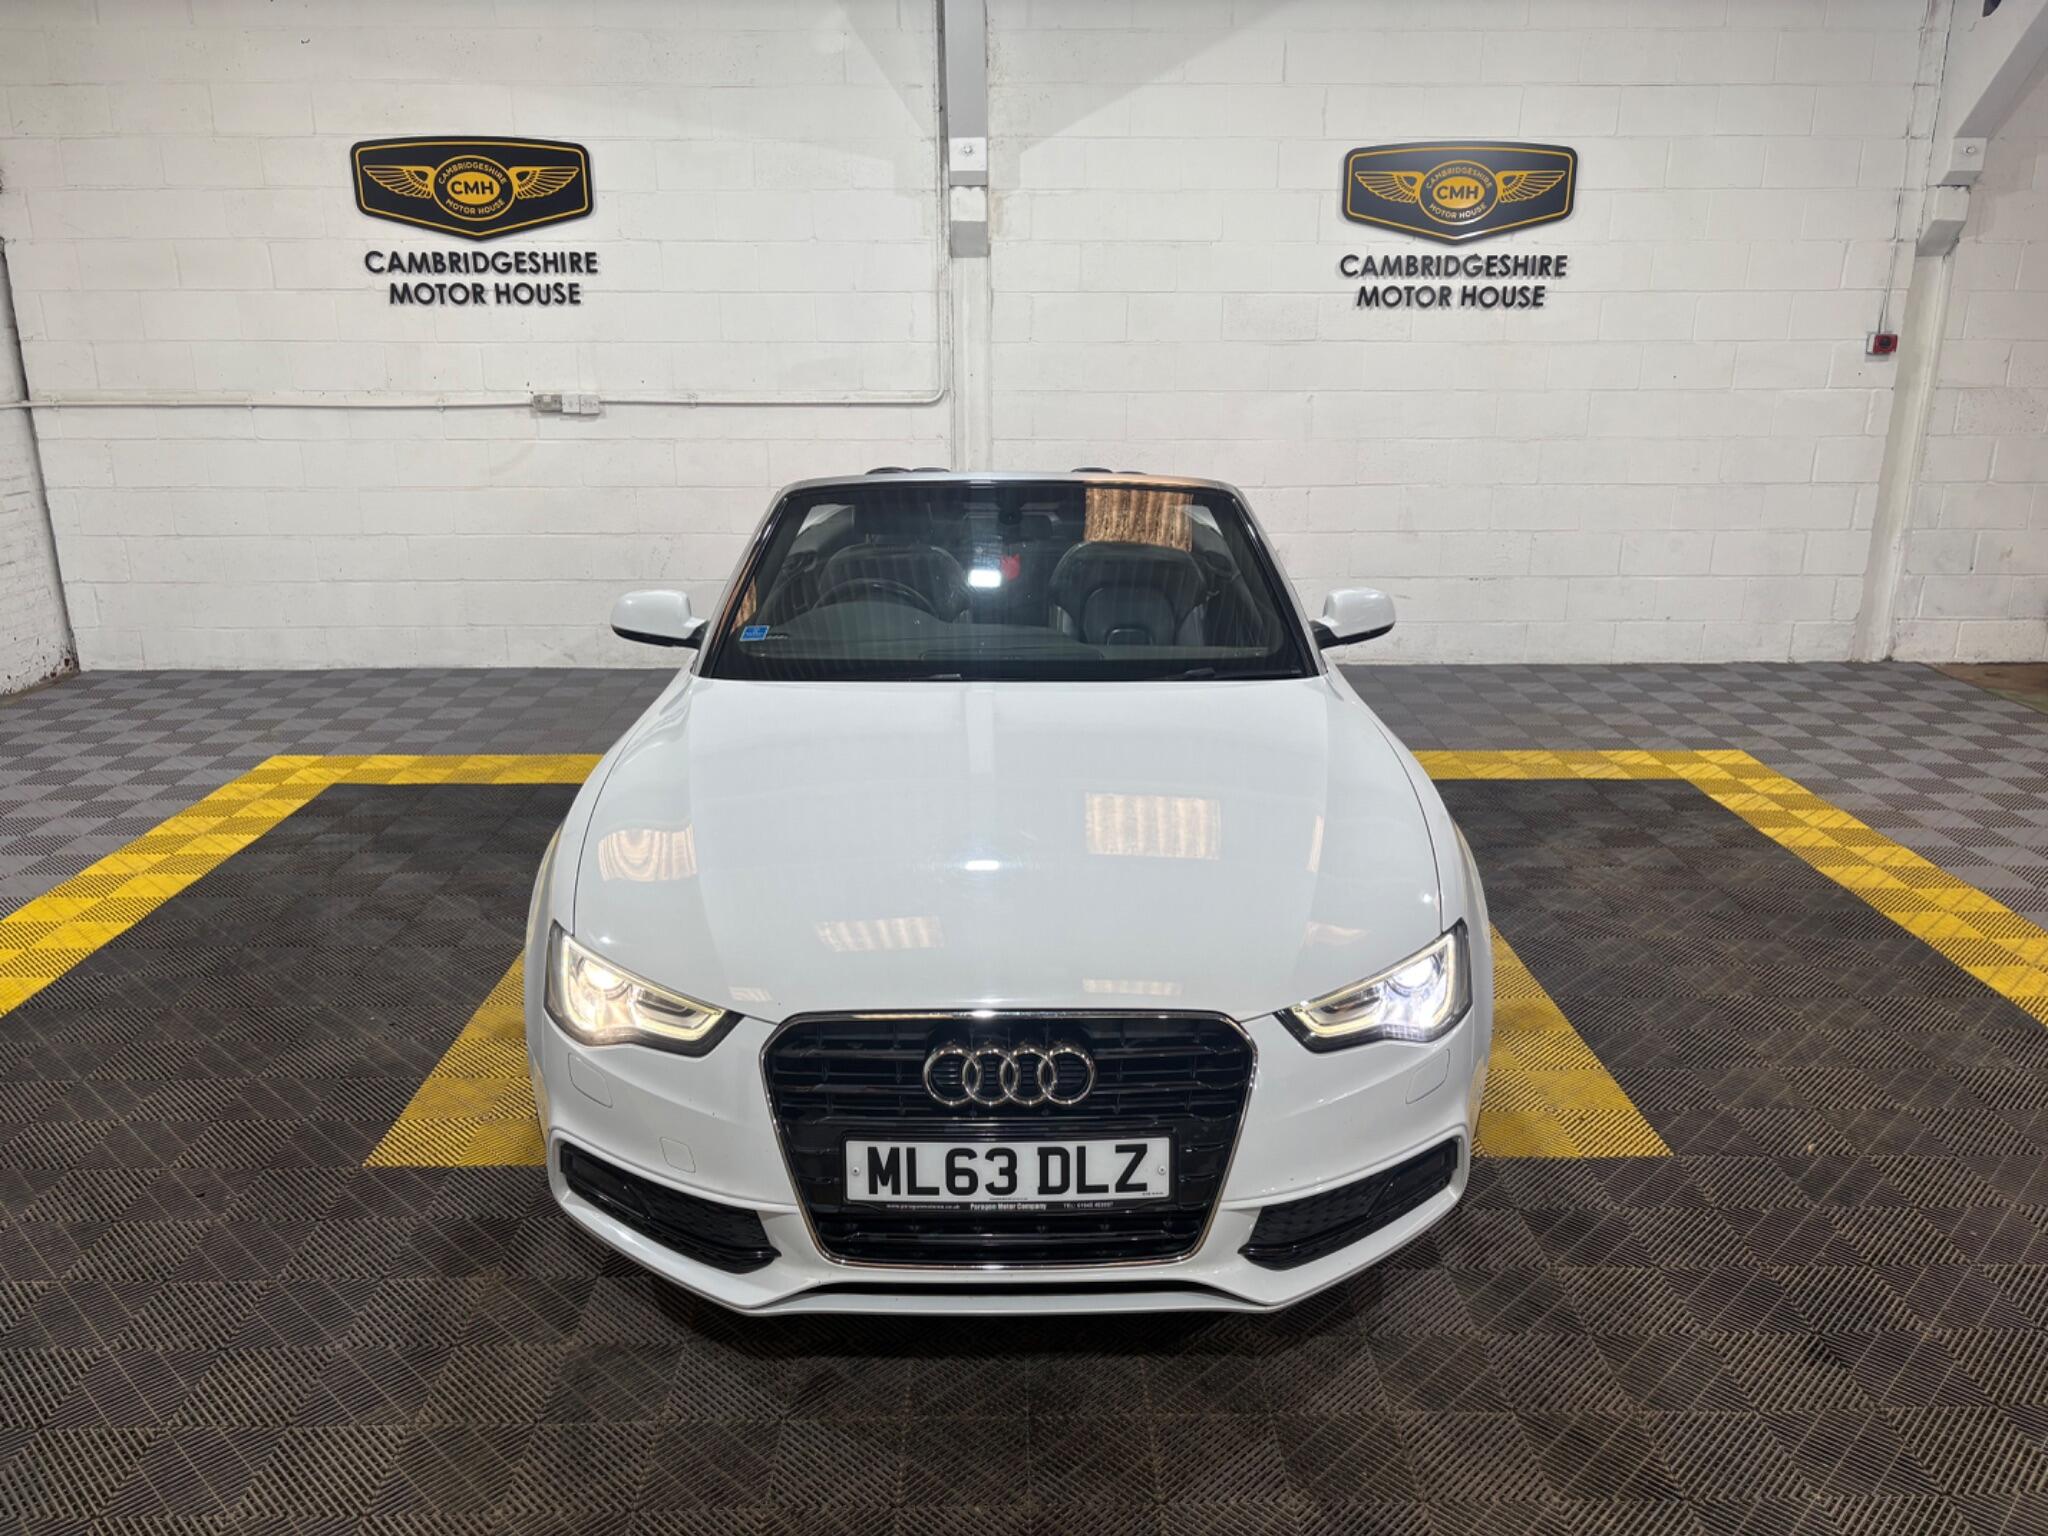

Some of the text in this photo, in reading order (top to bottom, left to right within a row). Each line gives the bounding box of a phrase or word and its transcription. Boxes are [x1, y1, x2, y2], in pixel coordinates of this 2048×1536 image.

[438, 161, 507, 184] CAMBRIDGESHIRE
[1426, 166, 1493, 189] CAMBRIDGESHIRE
[451, 181, 494, 195] CMH
[1437, 186, 1478, 200] CMH
[445, 198, 505, 214] MOTOR HOUSE
[1429, 202, 1487, 219] MOTOR HOUSE
[364, 250, 599, 274] CAMBRIDGESHIRE
[1340, 254, 1568, 277] CAMBRIDGESHIRE
[389, 282, 581, 305] MOTOR HOUSE
[1356, 285, 1546, 307] MOTOR HOUSE
[867, 1143, 1148, 1196] ML63 DLZ
[1017, 1202, 1047, 1212] Company
